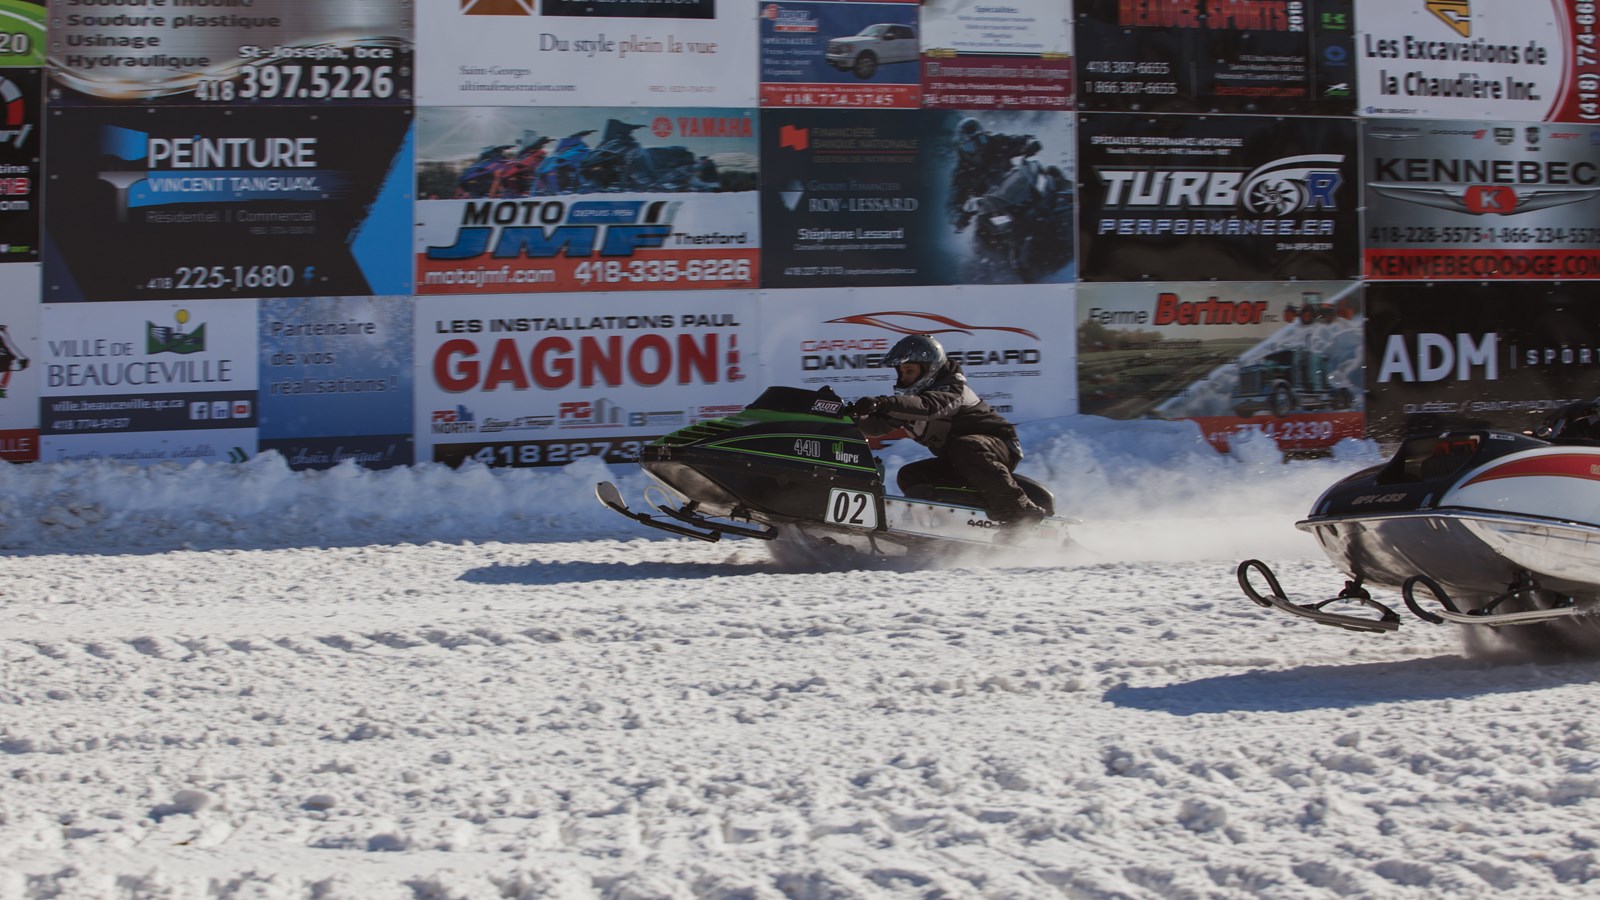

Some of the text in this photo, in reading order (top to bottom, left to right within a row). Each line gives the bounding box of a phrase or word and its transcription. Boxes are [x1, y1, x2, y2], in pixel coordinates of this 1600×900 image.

[67, 14, 281, 30] Soudure plastique
[67, 35, 160, 50] Usinage
[355, 47, 394, 59] bce
[539, 33, 718, 59] Du style plein la vue
[1364, 34, 1548, 66] Les Excavations de
[66, 54, 210, 71] Hydraulique
[195, 81, 235, 101] 418
[240, 66, 394, 99] 397.5226
[1379, 70, 1542, 101] la Chaudière Inc.
[676, 116, 753, 138] YAMAHA
[1374, 158, 1599, 185] KENNEBEC
[148, 177, 223, 193] VINCENT
[1480, 190, 1501, 209] K
[462, 200, 565, 225] MOTO
[425, 225, 673, 260] JMF
[673, 232, 748, 245] Thetford
[175, 264, 295, 289] 225-1680
[425, 267, 557, 288] motojmf.com
[574, 258, 752, 285] 418-335-6226
[1089, 307, 1148, 325] Ferme
[1153, 292, 1267, 326] Bertnor
[271, 318, 377, 337] Partenaire
[436, 313, 741, 334] LES INSTALLATIONS PAUL
[48, 339, 134, 358] VILLE DE
[271, 350, 336, 367] de vos
[1377, 332, 1498, 383] ADM
[433, 332, 720, 394] GAGNON
[802, 353, 888, 371] DANIE
[48, 359, 233, 388] BEAUCEVILLE
[271, 374, 386, 396] réalisations
[816, 401, 840, 411] KLOTZ
[473, 439, 657, 465] 418 227-3
[793, 439, 821, 458] 440
[836, 451, 860, 464] tigre
[832, 491, 868, 525] 02
